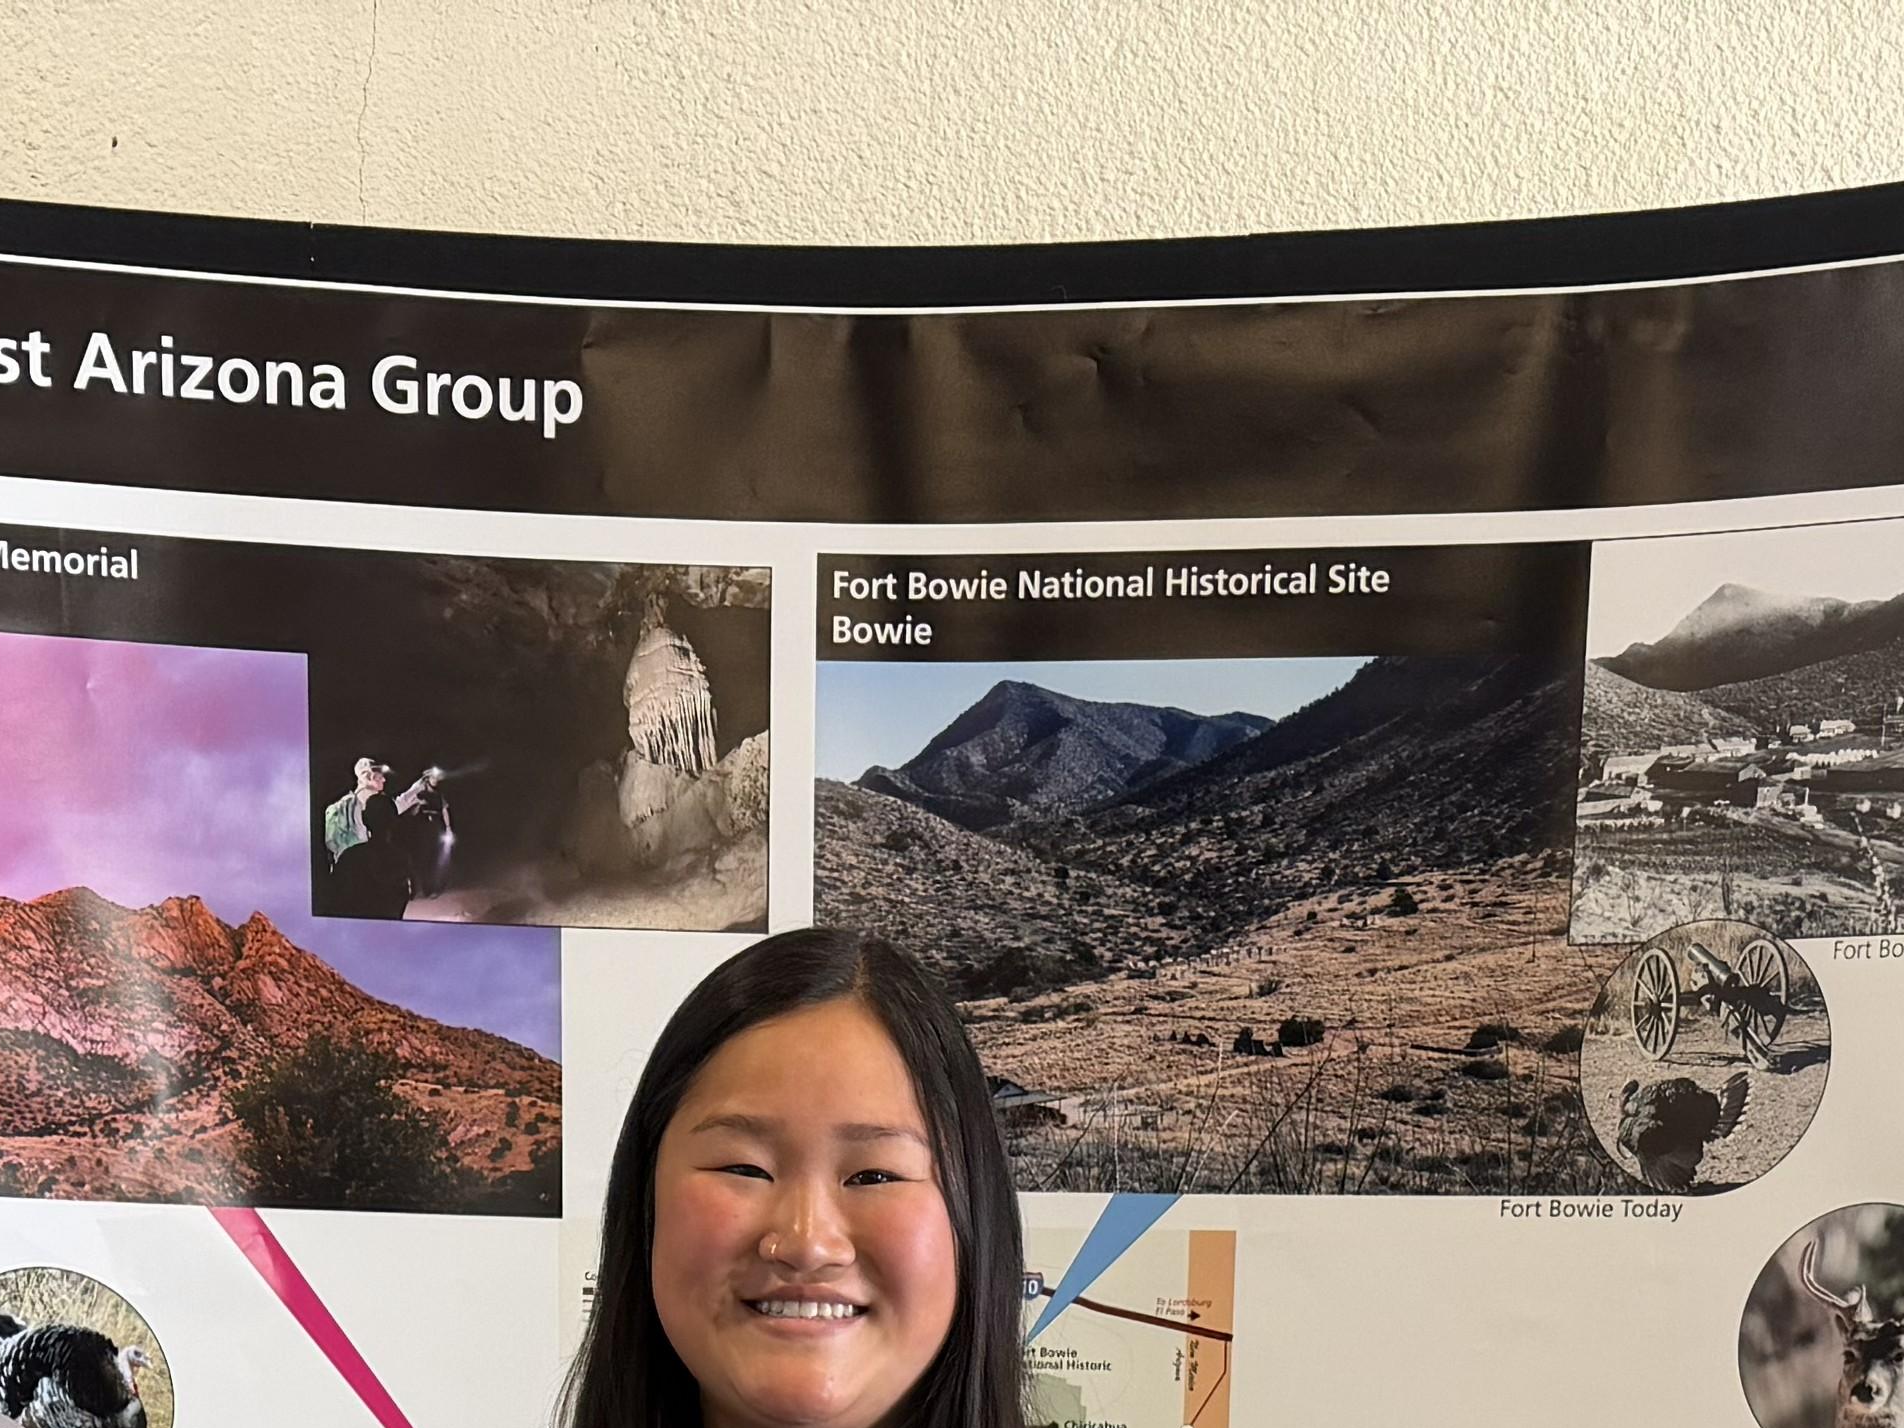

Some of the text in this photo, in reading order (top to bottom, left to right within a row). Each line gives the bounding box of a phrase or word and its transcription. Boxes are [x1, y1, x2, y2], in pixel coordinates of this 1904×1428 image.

[73, 332, 347, 410] Arizona
[370, 354, 585, 439] Group
[831, 561, 1391, 602] Fort Bowie National Historical Site
[831, 614, 934, 648] Bowie
[1832, 936, 1873, 964] Fort
[1498, 1197, 1684, 1227] Fort Bowie Today
[1039, 1346, 1078, 1359] Bowie
[1066, 1358, 1113, 1372] Historic
